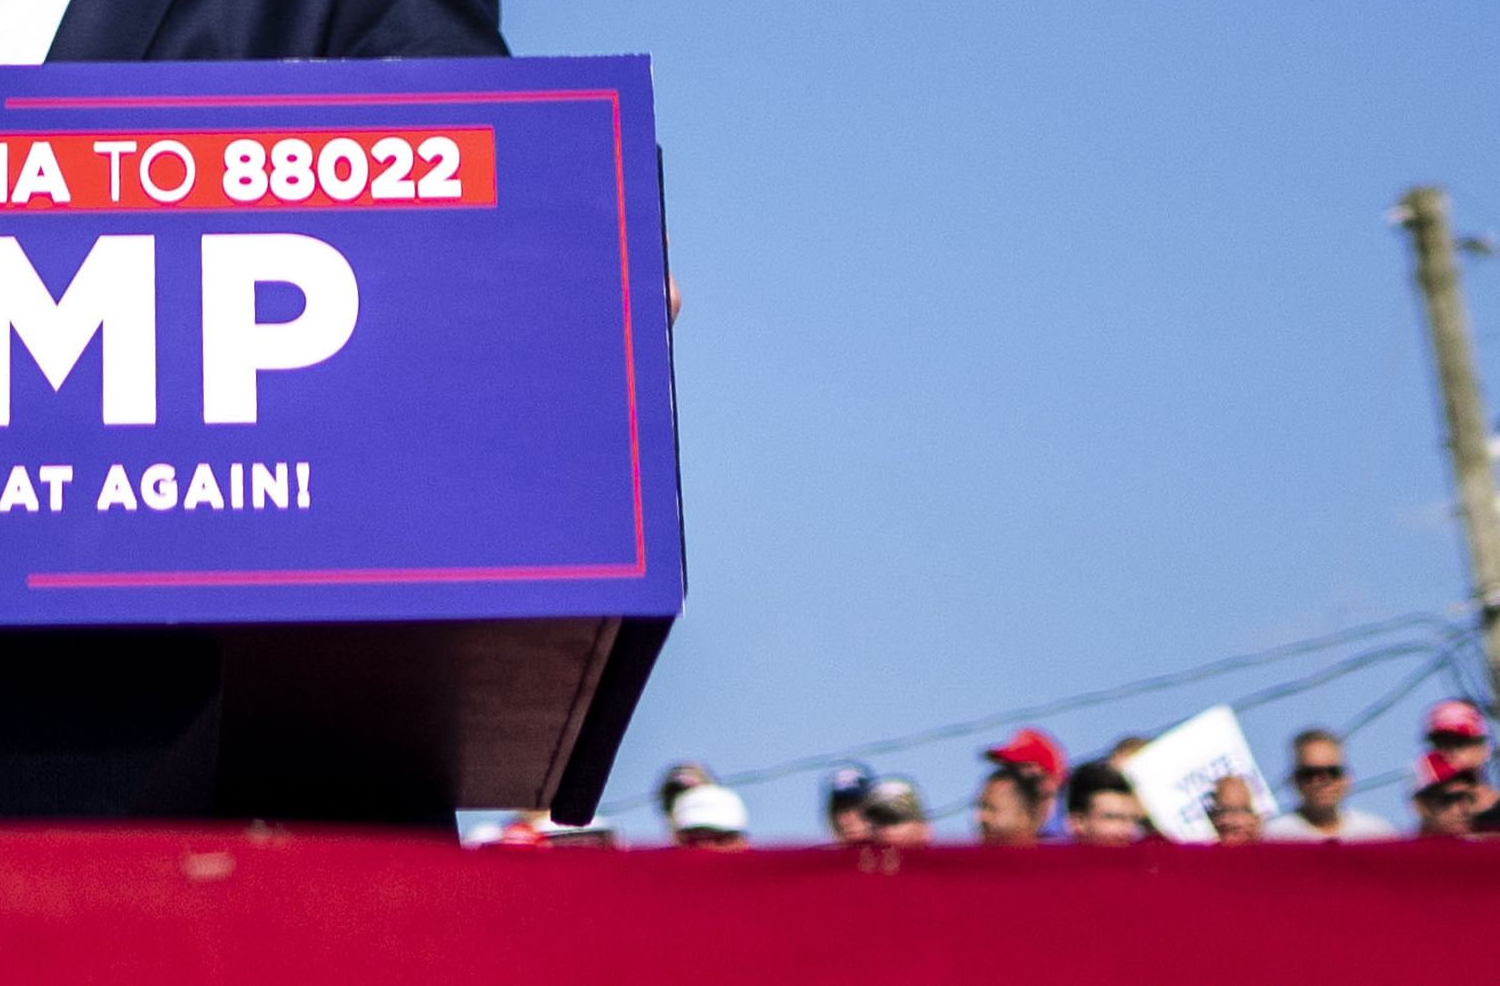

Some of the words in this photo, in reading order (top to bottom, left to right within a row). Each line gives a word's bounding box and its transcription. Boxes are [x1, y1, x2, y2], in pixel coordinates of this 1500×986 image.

[93, 139, 197, 203] TO
[221, 136, 463, 202] 88022
[96, 460, 311, 513] AGAIN!
